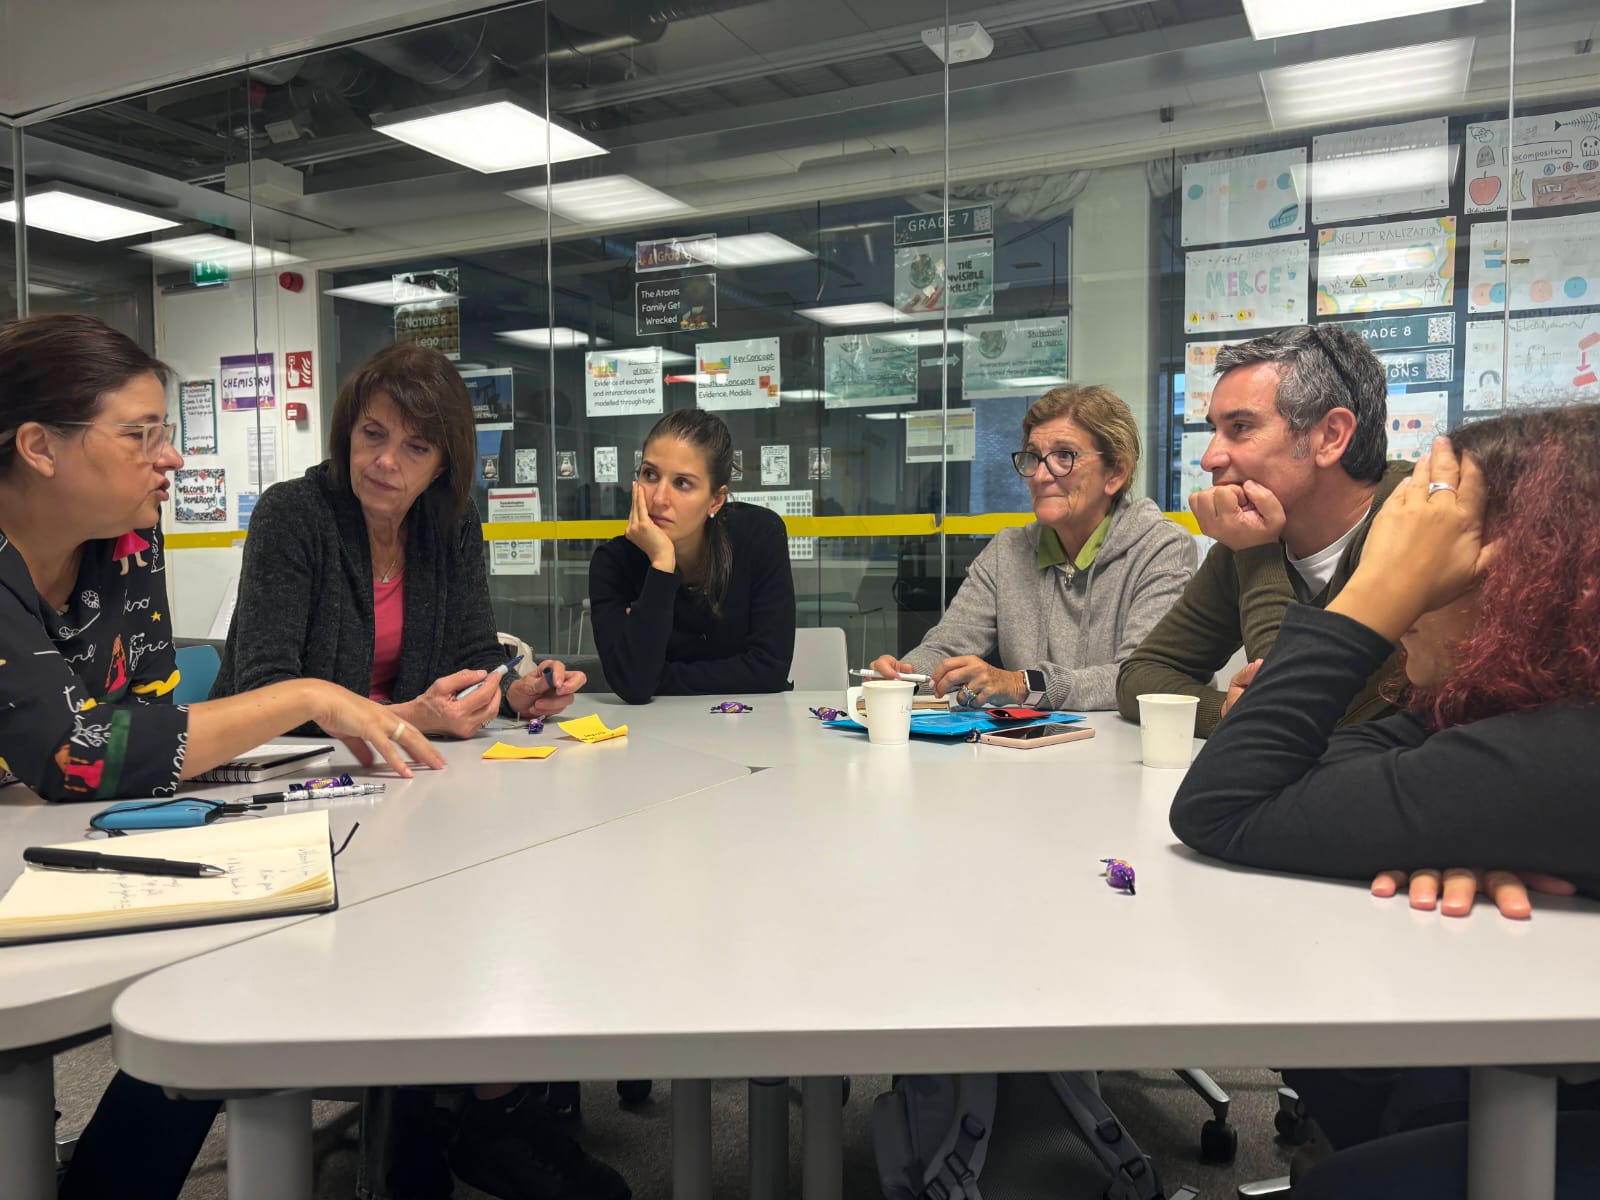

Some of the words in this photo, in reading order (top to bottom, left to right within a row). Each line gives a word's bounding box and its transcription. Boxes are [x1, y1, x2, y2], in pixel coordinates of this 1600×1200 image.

[1508, 147, 1568, 162] composition
[908, 215, 956, 231] GRADE
[962, 213, 969, 225] 7
[957, 260, 972, 270] THE
[948, 270, 984, 282] NVISIBLE
[1206, 266, 1281, 299] MERGE
[641, 290, 655, 298] The
[656, 288, 680, 297] Atoms
[642, 303, 666, 312] Family
[667, 301, 680, 310] Get
[405, 313, 446, 328] Nature's
[645, 315, 678, 325] Wrecked
[1361, 327, 1397, 339] RADE
[1403, 325, 1411, 336] 8
[416, 337, 439, 348] Lego
[733, 354, 745, 362] Key
[746, 352, 775, 361] Concept
[758, 364, 775, 373] Logic
[1395, 358, 1413, 368] OF
[223, 376, 270, 389] CHEMISTRY
[726, 378, 755, 386] oncepts
